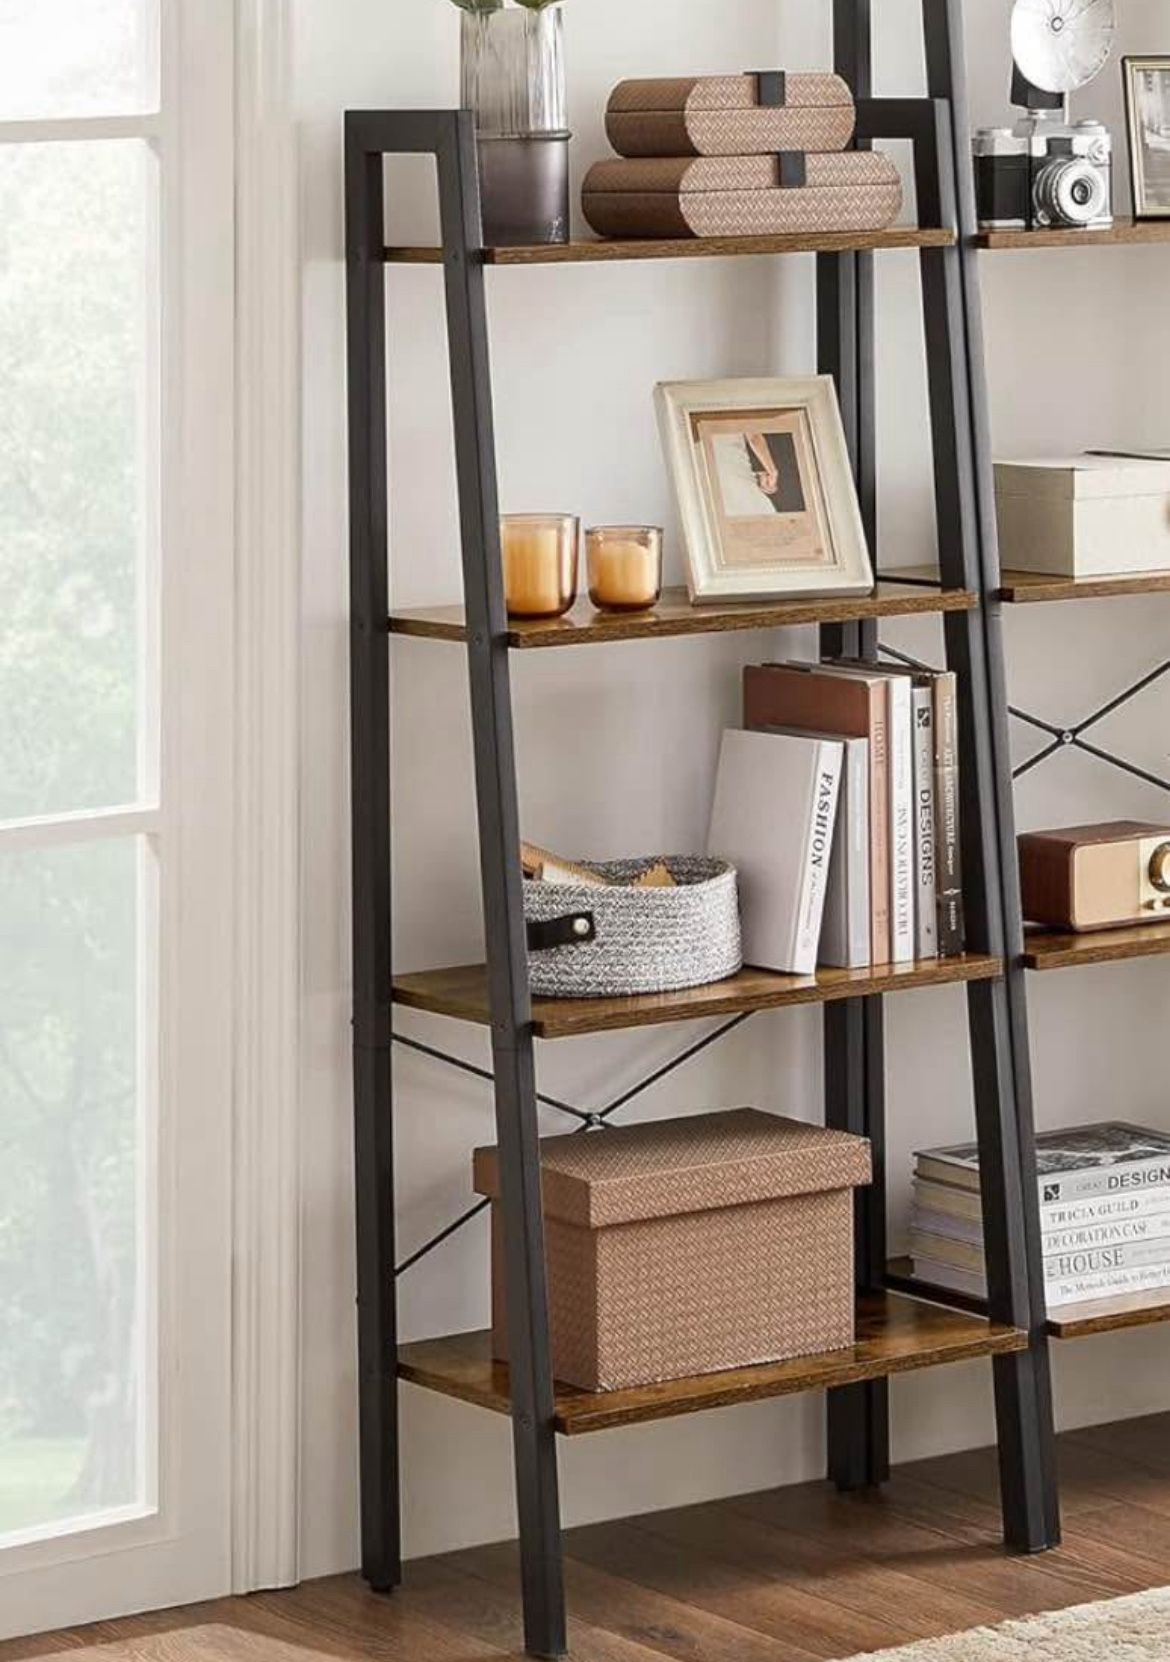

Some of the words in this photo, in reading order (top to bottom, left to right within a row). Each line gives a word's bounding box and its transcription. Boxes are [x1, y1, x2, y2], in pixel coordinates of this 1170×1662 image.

[811, 773, 834, 868] FASHION
[920, 790, 933, 886] DESIGNS
[1098, 1199, 1139, 1216] GUILD
[1058, 1248, 1125, 1276] HOUSE
